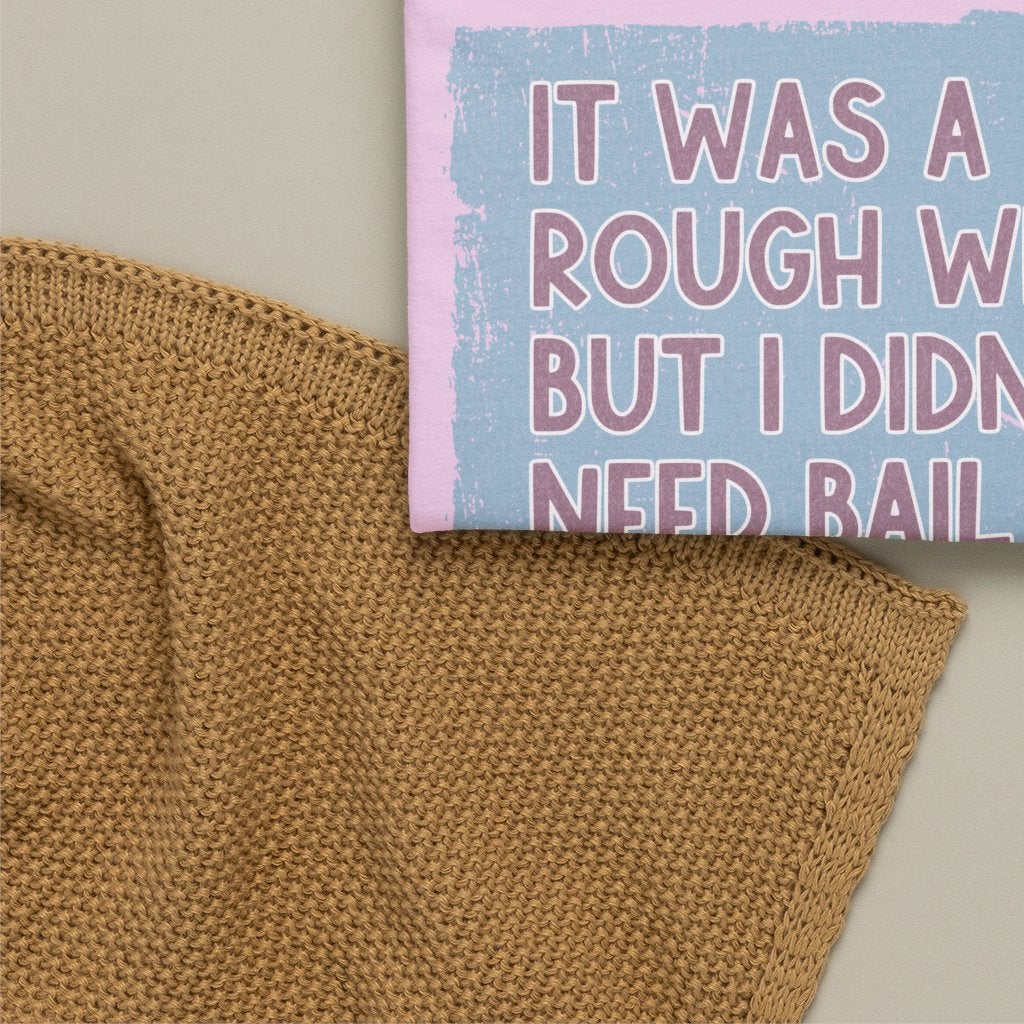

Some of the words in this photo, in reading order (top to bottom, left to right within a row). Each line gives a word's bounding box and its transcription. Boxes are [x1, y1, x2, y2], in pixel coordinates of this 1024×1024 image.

[530, 80, 618, 185] IT
[652, 77, 889, 184] WAS
[923, 76, 990, 181] A
[530, 205, 882, 310] ROUGH
[530, 332, 724, 435] BUT
[759, 332, 784, 434] I
[529, 458, 771, 537] NEED
[805, 458, 1014, 543] BAIL
